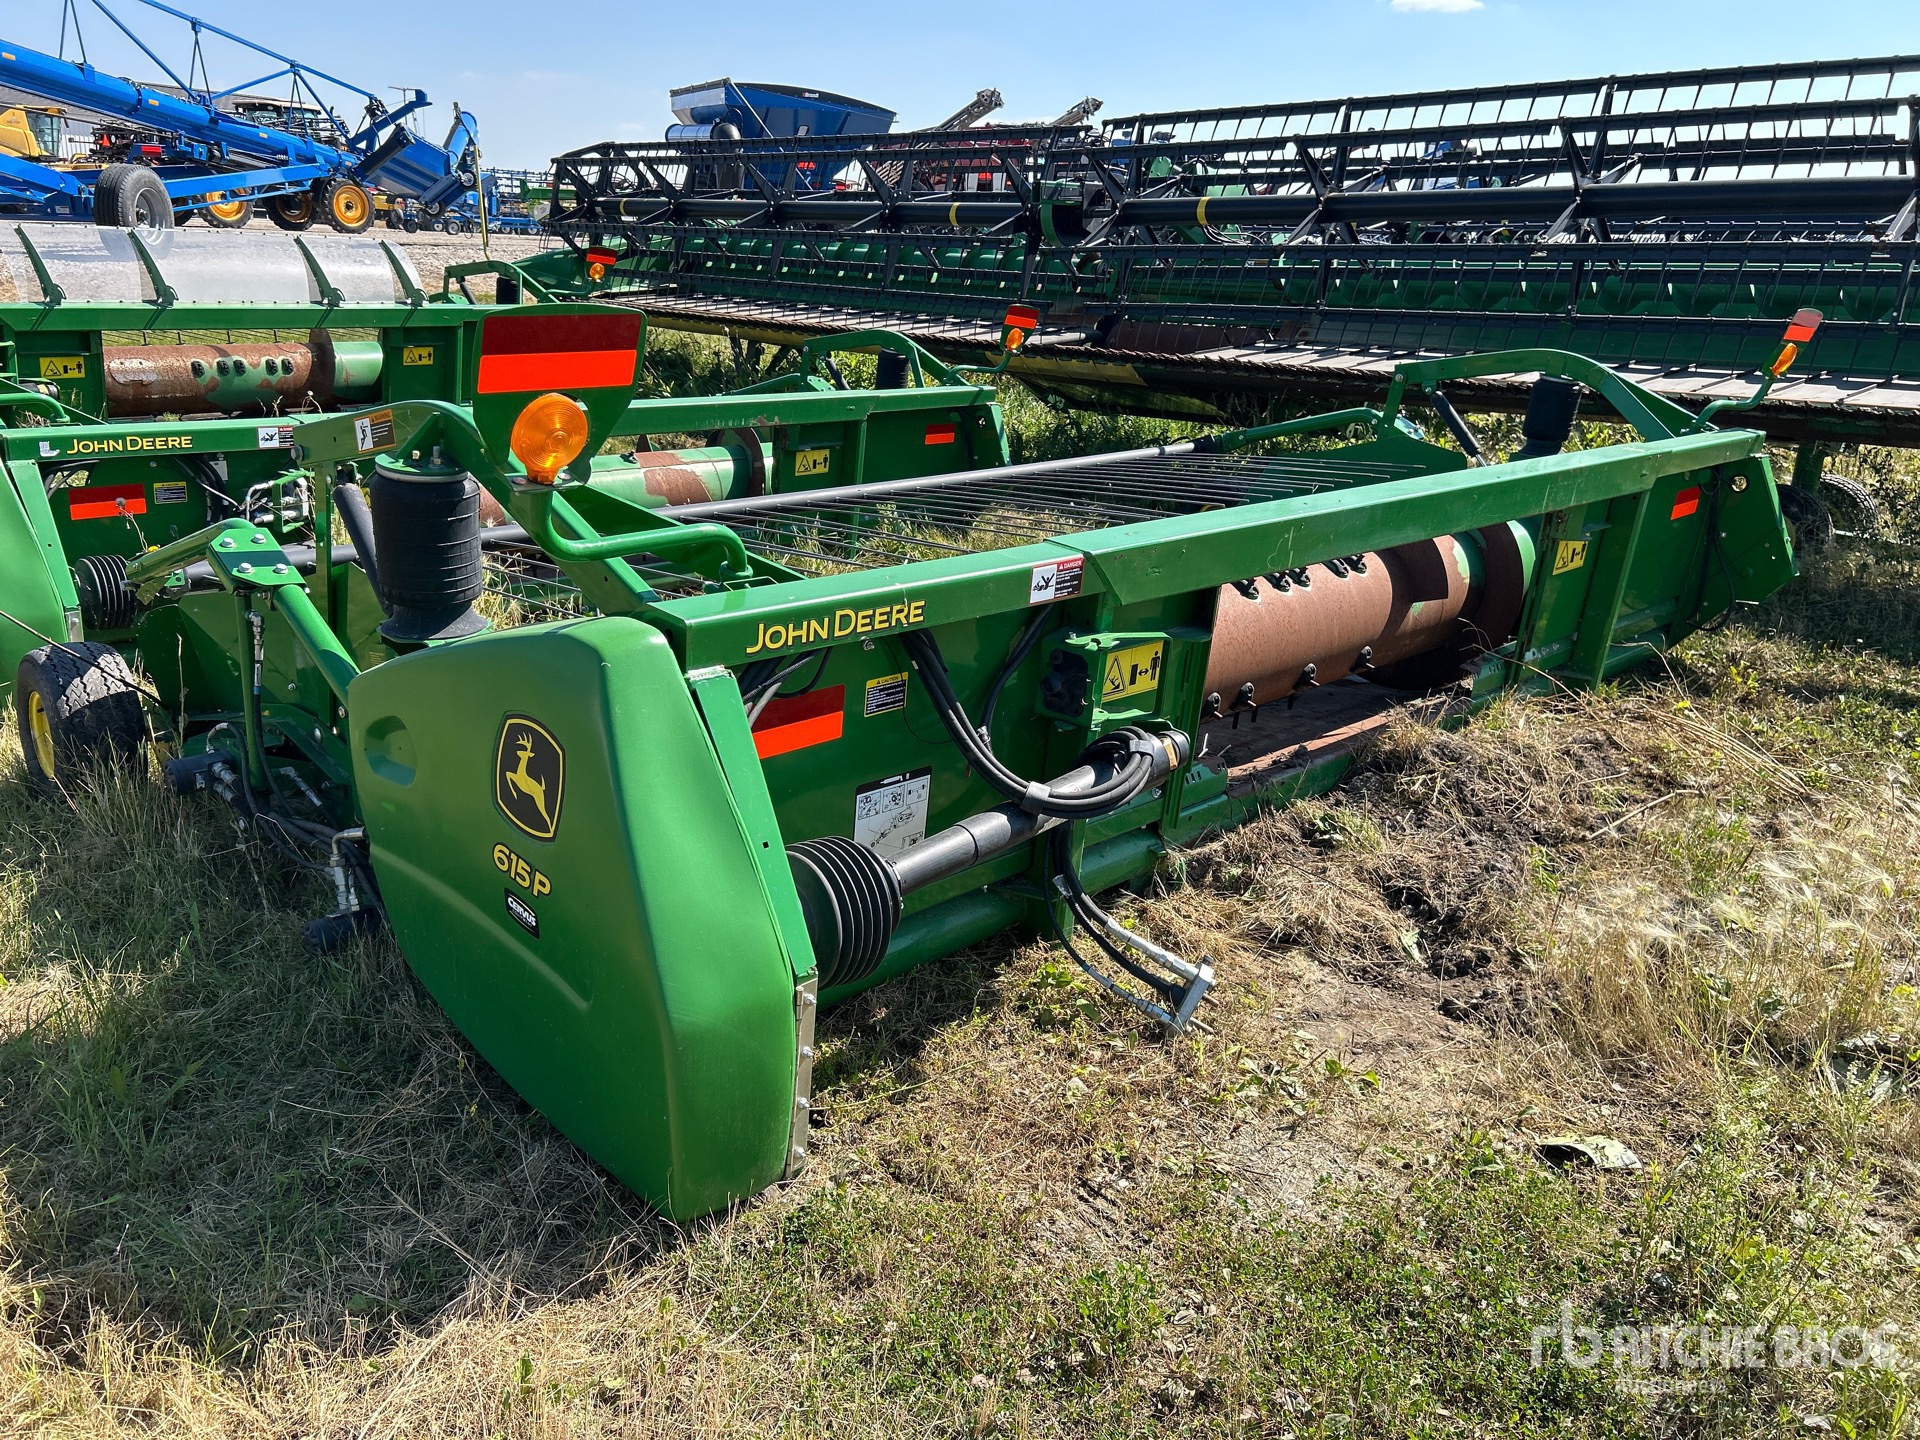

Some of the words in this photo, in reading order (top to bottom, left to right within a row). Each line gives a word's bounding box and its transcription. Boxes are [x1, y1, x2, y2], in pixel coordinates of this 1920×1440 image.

[66, 438, 123, 454] JOHN
[126, 436, 193, 450] DEERE
[1063, 560, 1082, 569] DANGER
[746, 617, 829, 654] JOHN
[834, 600, 925, 637] DEERE
[493, 844, 551, 897] 615P
[507, 897, 537, 926] CERVUS
